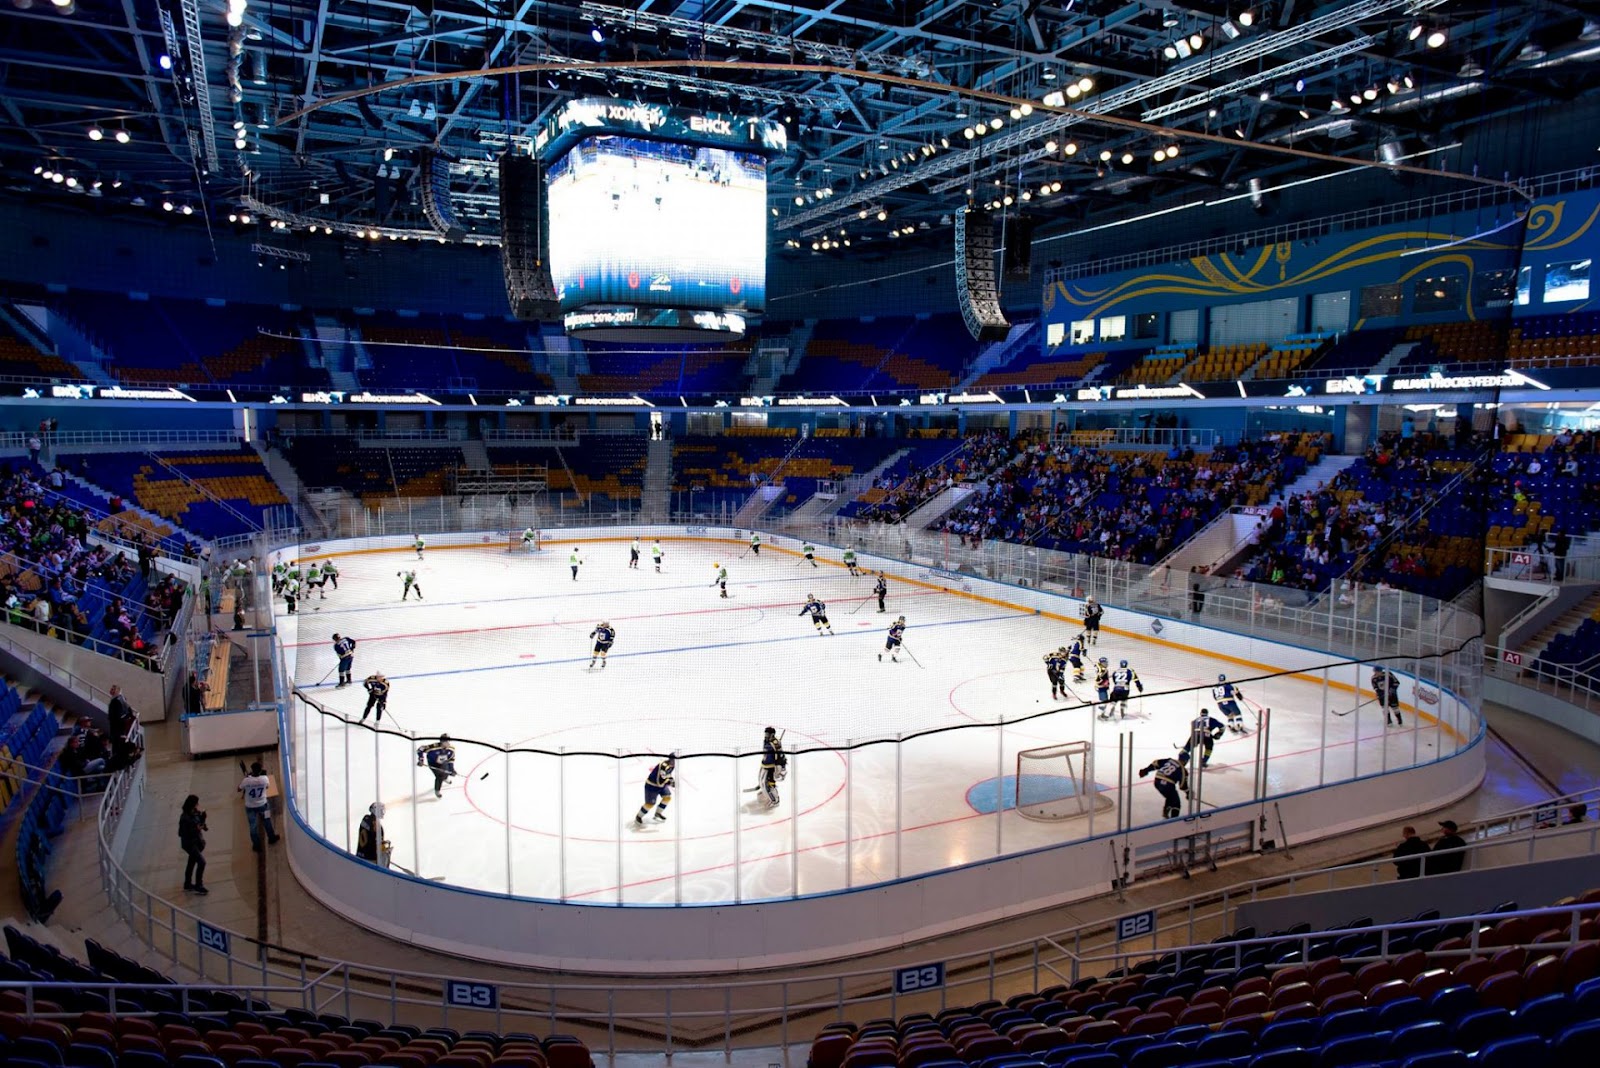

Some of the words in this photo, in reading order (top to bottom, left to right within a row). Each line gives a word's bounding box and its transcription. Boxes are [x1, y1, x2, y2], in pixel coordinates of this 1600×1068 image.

[1514, 554, 1530, 564] A1
[1505, 654, 1520, 665] A1
[1114, 672, 1128, 682] 22
[1160, 762, 1176, 776] 28
[249, 787, 265, 799] 47
[1121, 914, 1150, 937] B2
[201, 927, 225, 950] B4
[901, 966, 938, 990] B3
[452, 984, 491, 1006] B3
